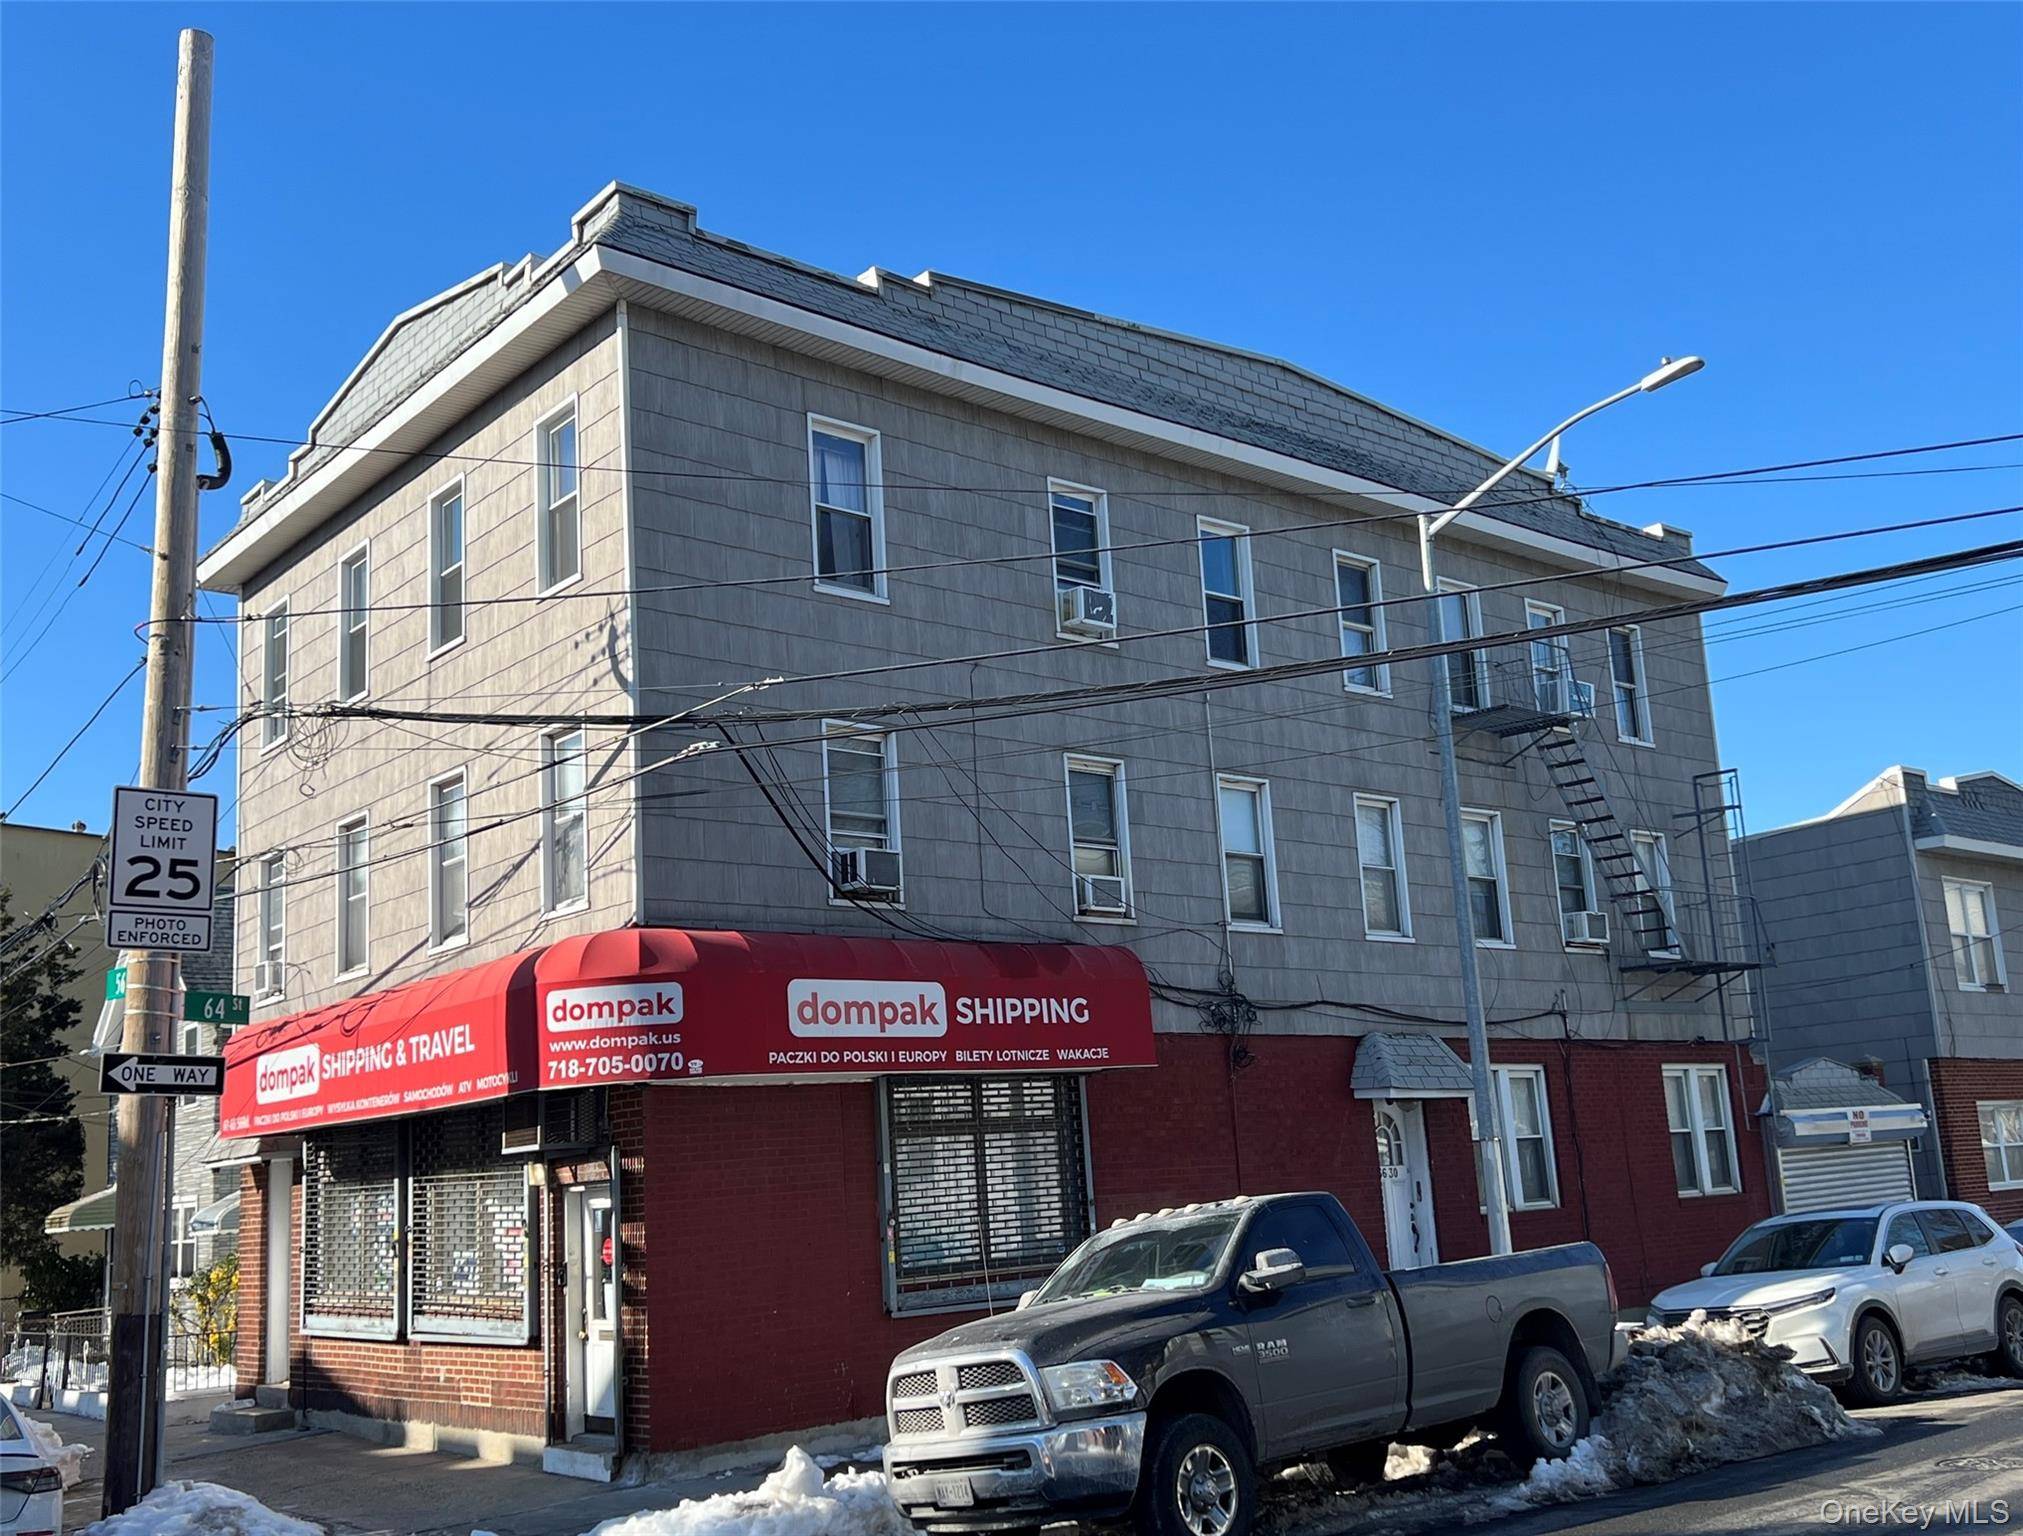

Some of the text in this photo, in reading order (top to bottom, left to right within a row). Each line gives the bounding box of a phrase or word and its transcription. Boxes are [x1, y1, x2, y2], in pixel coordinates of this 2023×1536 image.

[145, 798, 186, 813] CITY
[134, 815, 193, 832] SPEED
[140, 834, 187, 850] LIMIT
[125, 855, 201, 900] 25
[134, 917, 186, 931] PHOTO
[117, 930, 202, 945] ENFORCED
[204, 997, 243, 1019] 64 St
[552, 992, 676, 1023] dompak
[797, 992, 1090, 1033] dompak SHIPPING
[549, 1032, 681, 1052] www.dompak.us
[259, 1024, 475, 1094] dompak SHIPPING & TRAVEL
[768, 1047, 1109, 1064] PACZKI DO POLSKI I EUROPY BILETY LOTNICZE WAKACJE
[547, 1052, 684, 1079] 718-705-0070
[121, 1066, 209, 1083] ONE WAY
[403, 1084, 453, 1102] SAMOCHODÓW
[458, 1080, 473, 1093] ATV
[476, 1070, 518, 1091] MOTOCYKLI
[1852, 1110, 1865, 1120] NO
[1379, 1167, 1399, 1178] 630
[1256, 1339, 1287, 1350] RAM
